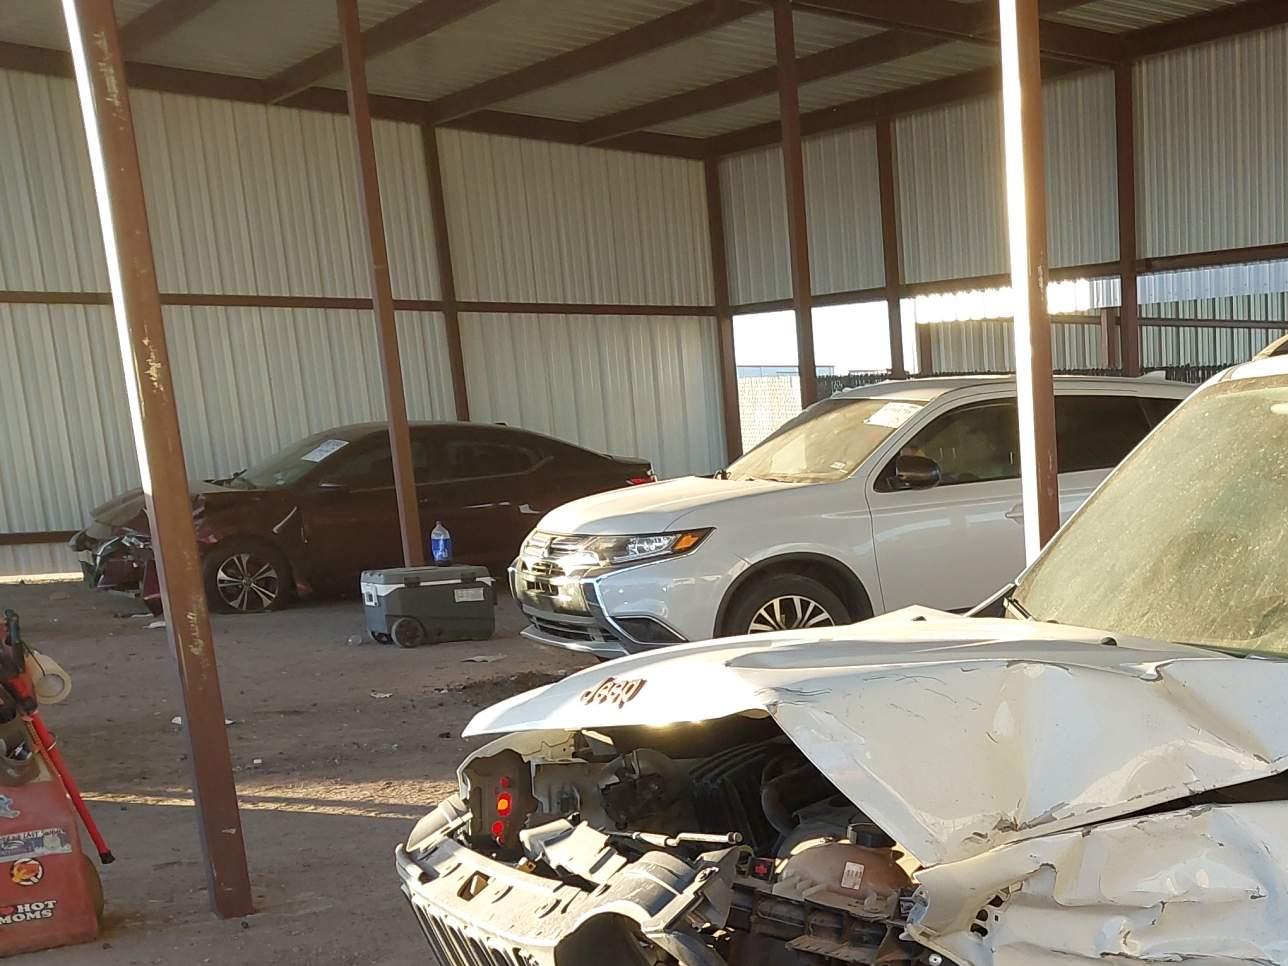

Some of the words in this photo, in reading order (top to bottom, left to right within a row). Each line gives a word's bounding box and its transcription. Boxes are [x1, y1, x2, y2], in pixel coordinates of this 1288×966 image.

[580, 677, 647, 709] Jeep
[16, 900, 57, 913] HOT
[0, 909, 52, 924] MOMS
